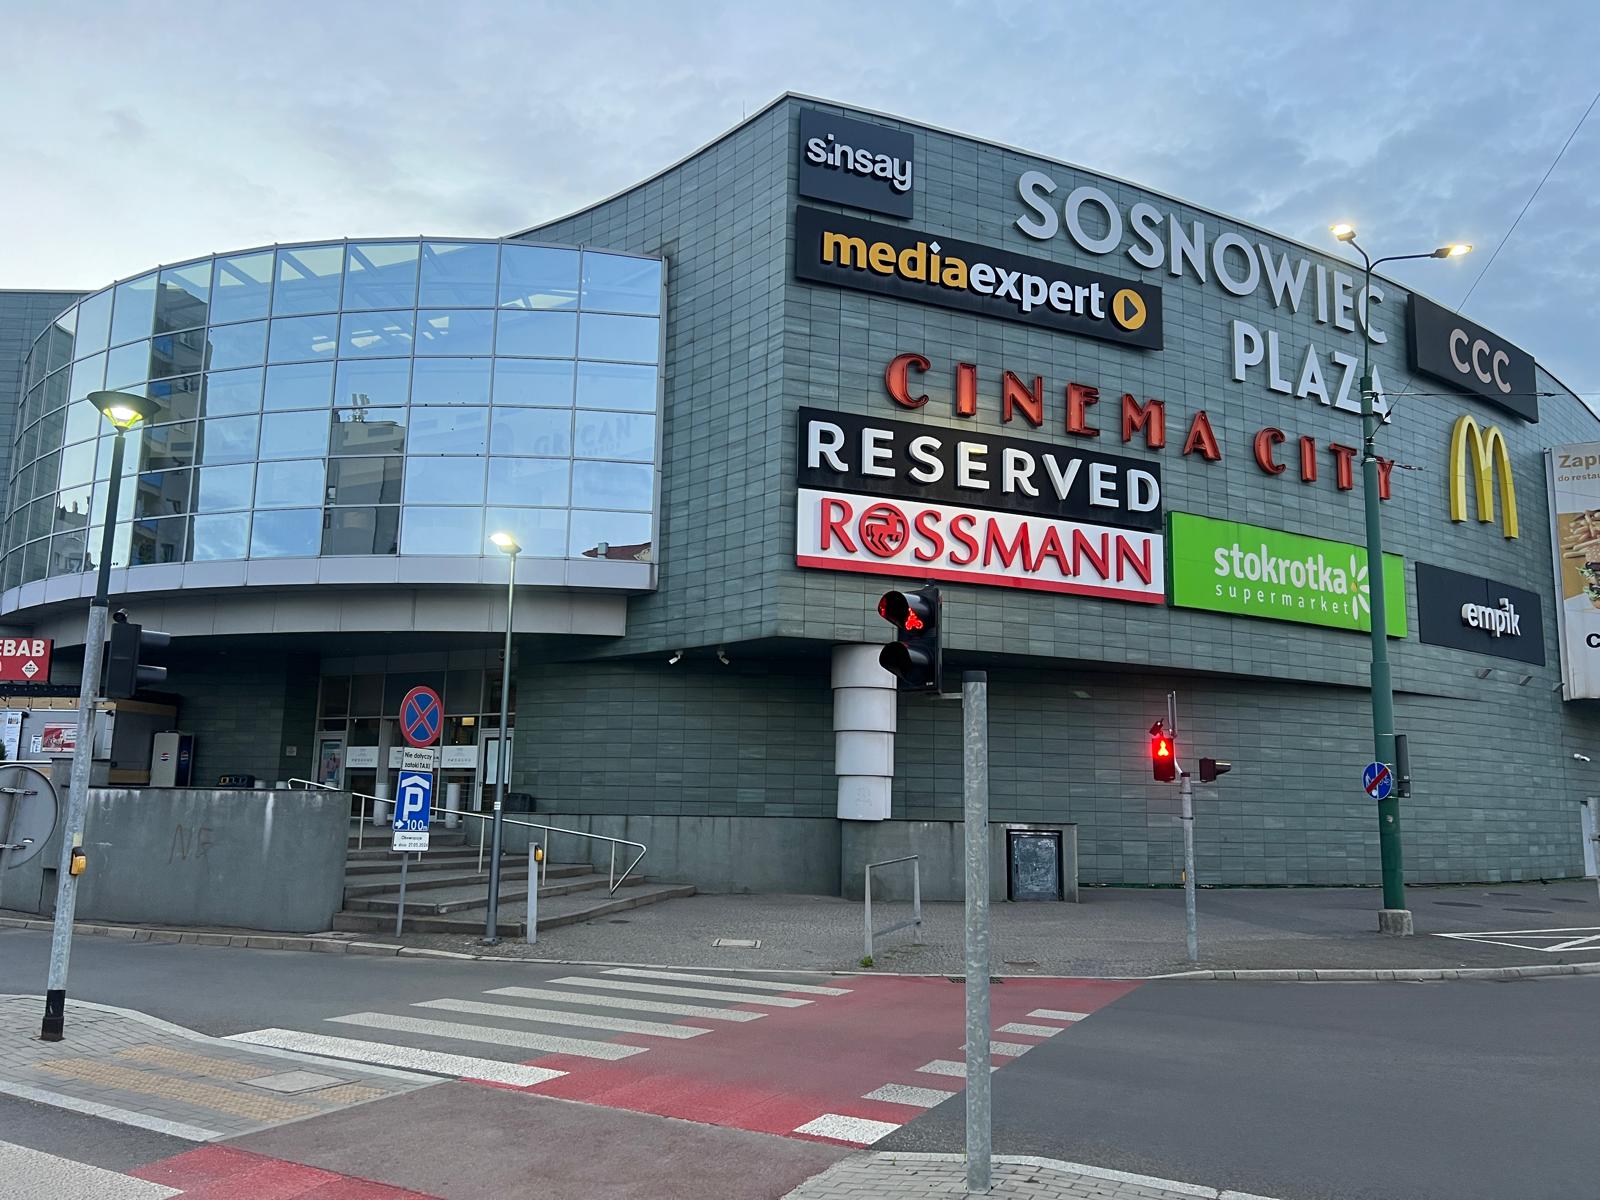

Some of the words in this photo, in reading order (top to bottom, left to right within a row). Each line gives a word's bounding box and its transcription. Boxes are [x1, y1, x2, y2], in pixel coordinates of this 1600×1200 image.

[807, 134, 912, 191] sinsay
[822, 231, 1105, 318] mediaexpert
[1014, 171, 1388, 345] SOSNOWIEC
[1231, 319, 1391, 424] PLAZA
[1450, 328, 1512, 393] CCC
[885, 353, 1221, 461] CINEMA
[1254, 427, 1395, 500] CITY
[807, 420, 1160, 512] RESERVED
[1558, 454, 1600, 470] Zap
[1558, 474, 1570, 482] do
[820, 497, 1153, 585] ROSSMANN
[1214, 543, 1348, 595] stokrotka
[1216, 584, 1349, 615] supermarket
[1462, 597, 1521, 638] empik
[403, 787, 424, 821] P
